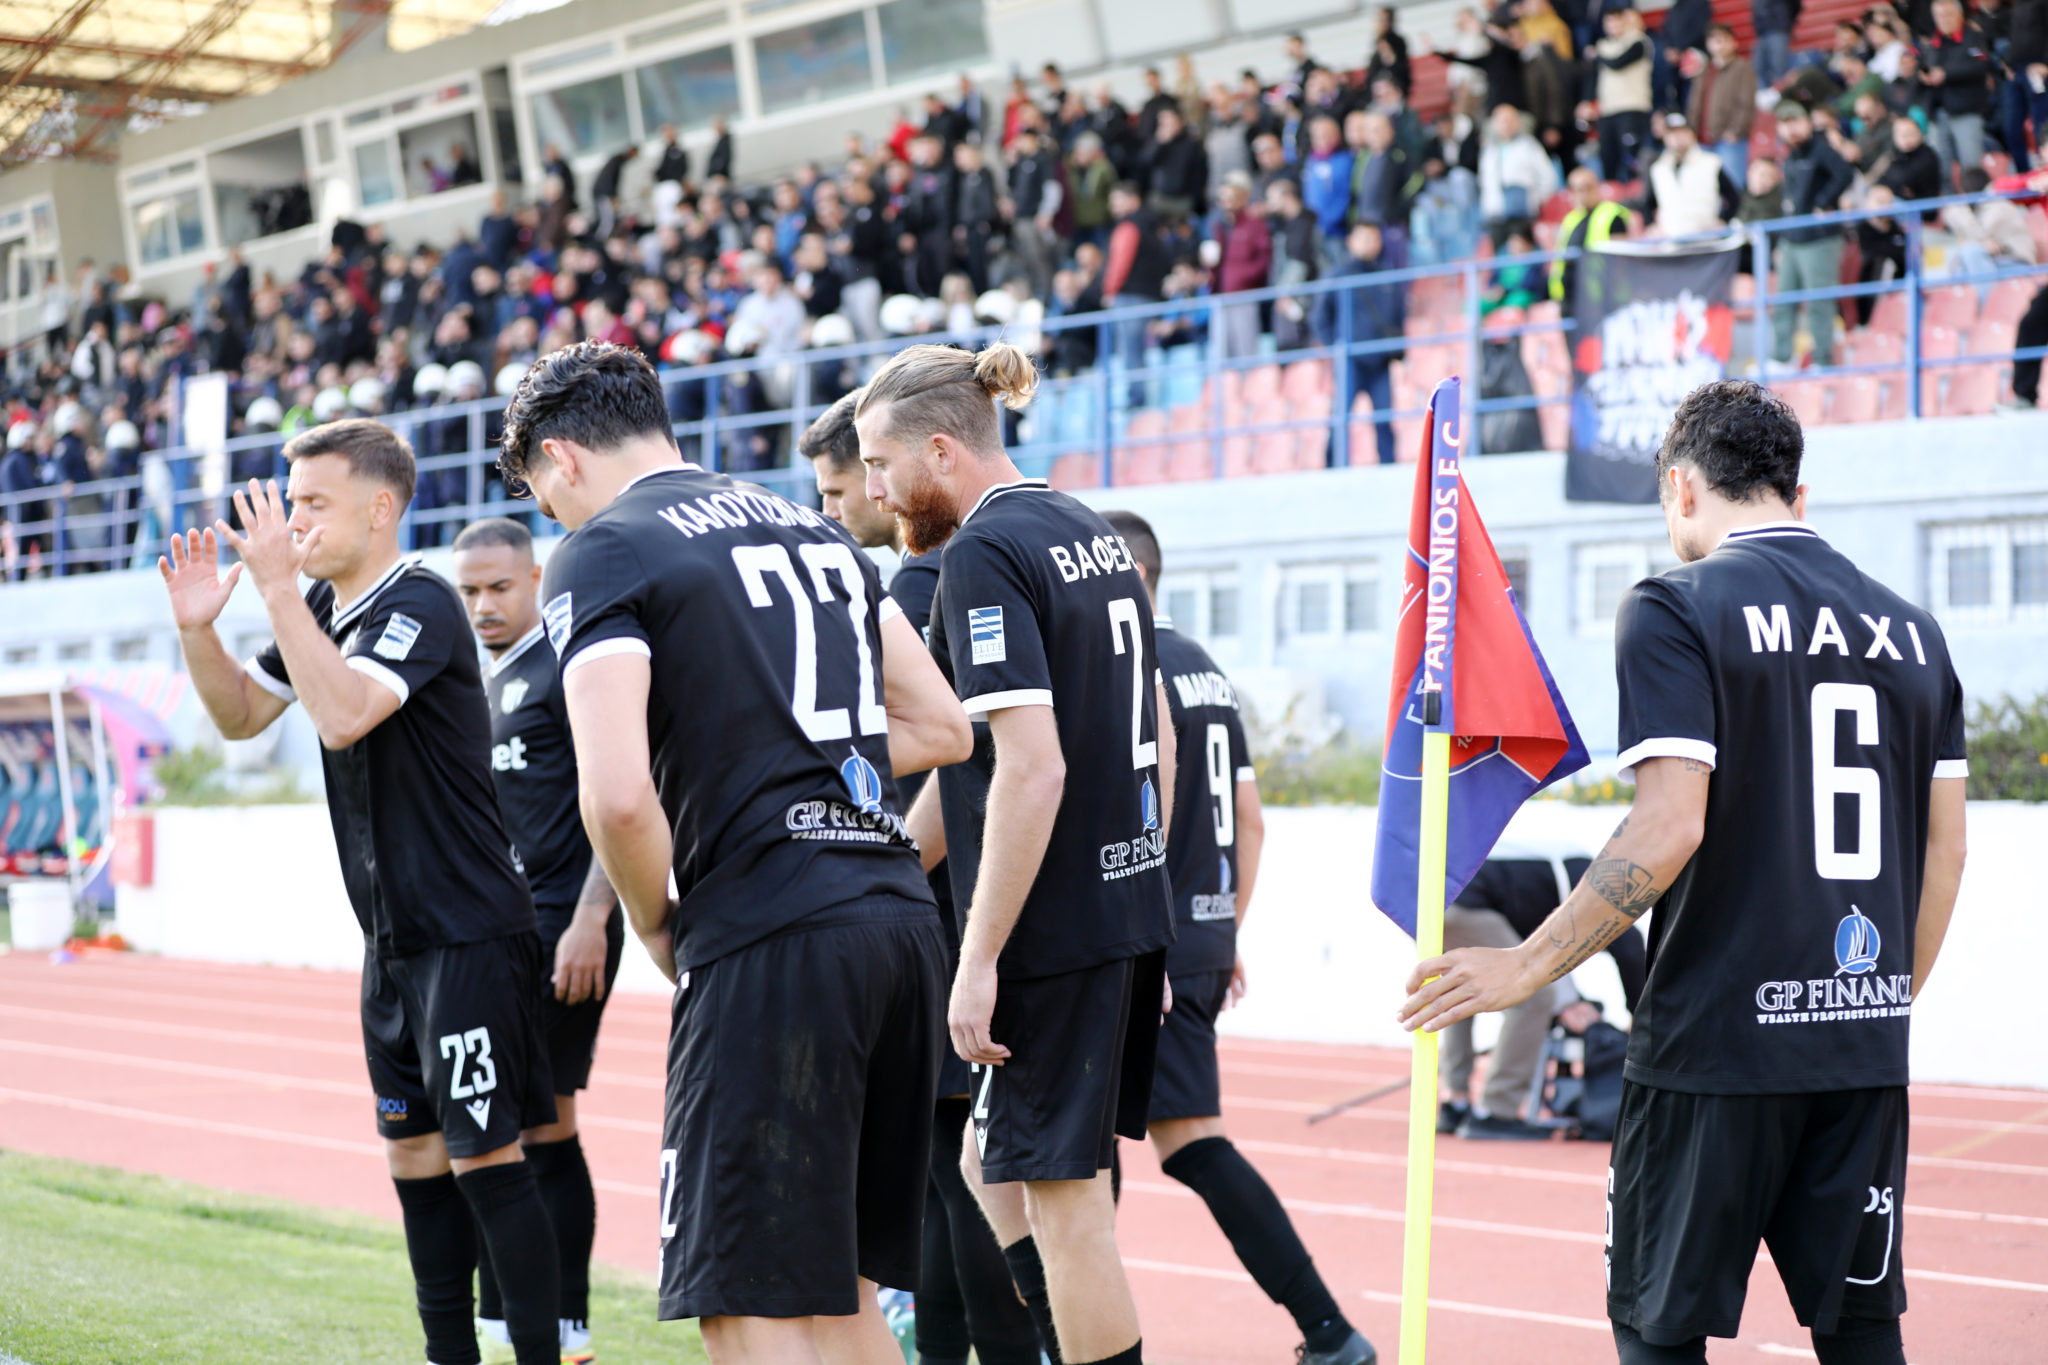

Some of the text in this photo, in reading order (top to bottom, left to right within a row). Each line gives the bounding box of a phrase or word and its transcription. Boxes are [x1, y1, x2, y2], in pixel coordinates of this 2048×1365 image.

[1437, 458, 1460, 476] F
[1424, 487, 1460, 692] PANIONIOS
[731, 543, 888, 742] 22
[1742, 604, 1926, 666] MAXI
[1108, 597, 1158, 770] 2
[492, 736, 528, 772] et
[1811, 682, 1881, 880] 6
[1207, 723, 1234, 847] 9
[786, 800, 827, 831] GP
[1100, 841, 1130, 870] GP
[1756, 981, 1803, 1011] GP
[1756, 1012, 1810, 1024] WEALTH
[1811, 1007, 1888, 1022] PROTECTION
[439, 1026, 497, 1100] 23
[971, 1061, 993, 1119] 2
